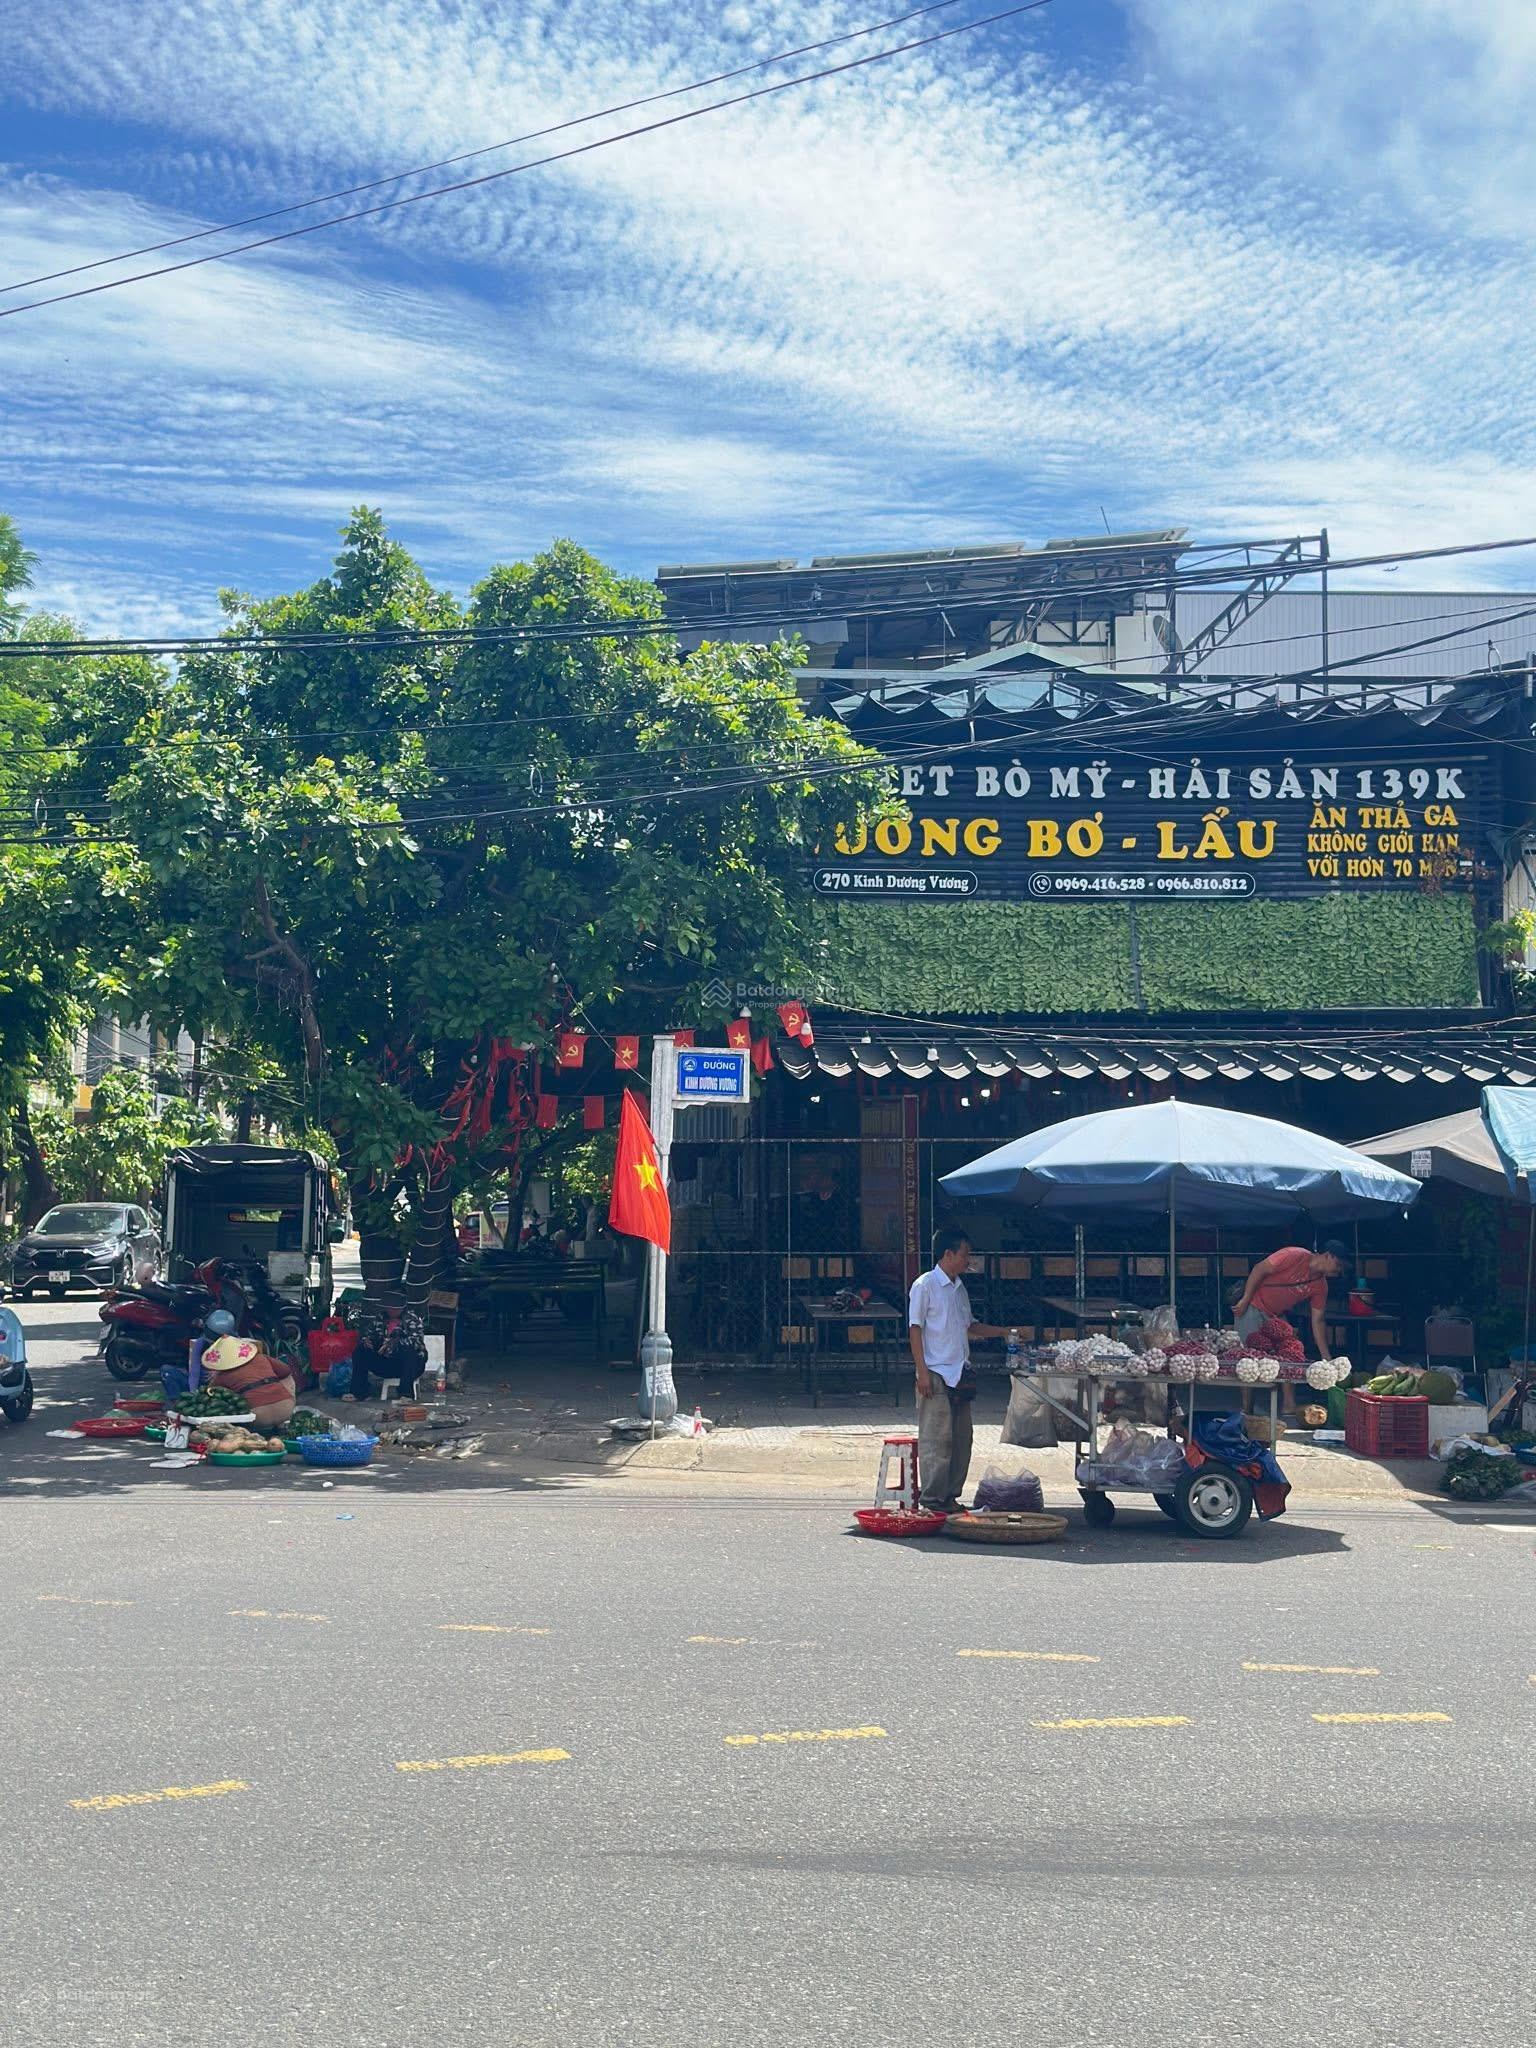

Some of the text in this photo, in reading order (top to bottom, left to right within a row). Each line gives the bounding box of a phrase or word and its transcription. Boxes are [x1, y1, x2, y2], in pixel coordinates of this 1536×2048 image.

[975, 758, 1031, 798] BÒ
[1049, 760, 1112, 799] MỸ
[1121, 779, 1136, 789] -
[1148, 758, 1231, 799] HẢI
[1249, 758, 1340, 799] SẢN
[1356, 768, 1466, 799] 139K
[1309, 800, 1459, 829] ĂN THẢ GA
[1026, 811, 1104, 858] BƠ
[1122, 837, 1137, 849] -
[1156, 806, 1278, 859] LẨU
[1307, 830, 1367, 853] KHÔNG
[1377, 830, 1414, 854] GIỚI
[1307, 854, 1458, 878] VỚI HƠN 70 MN
[822, 873, 969, 892] 270 Kinh Dương Vương
[1055, 877, 1146, 892] 0969.416.528
[1156, 877, 1248, 891] 0966.810.812
